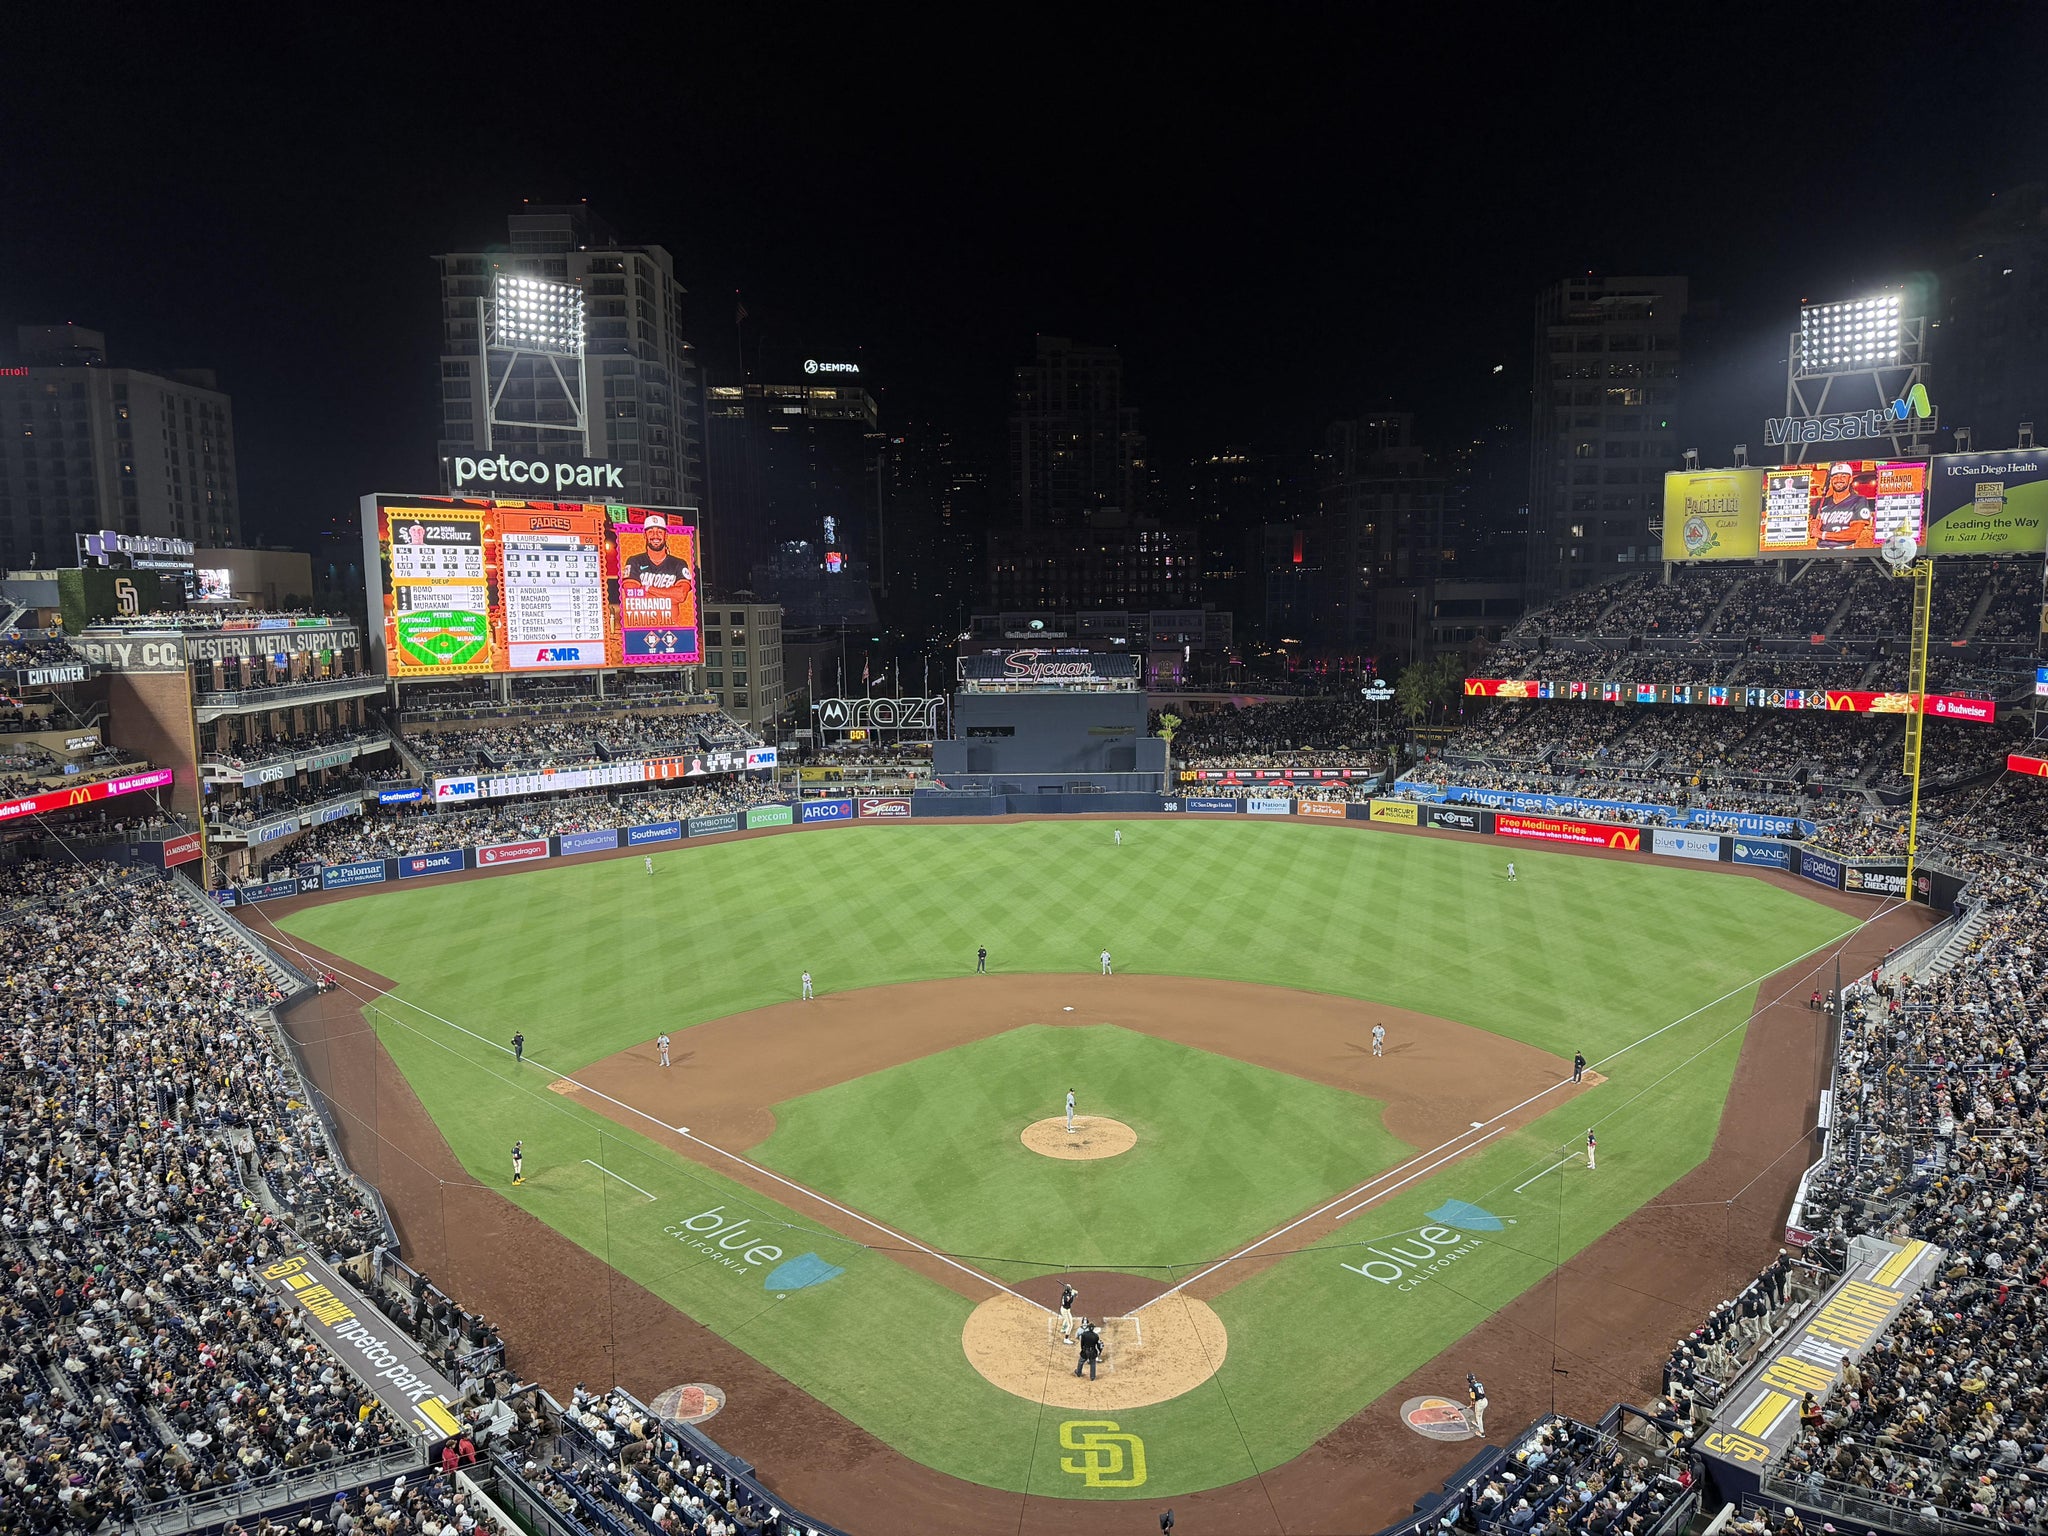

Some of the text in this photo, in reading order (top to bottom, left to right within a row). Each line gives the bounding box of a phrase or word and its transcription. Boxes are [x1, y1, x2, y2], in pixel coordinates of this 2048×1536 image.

[819, 363, 860, 373] SEMPRA
[1768, 409, 1881, 445] Viasat
[455, 454, 624, 492] petco park
[1947, 463, 2038, 476] UC San Diego Health
[530, 517, 571, 531] PADRES
[1946, 518, 2039, 529] Leading the Way
[426, 526, 440, 539] 22
[441, 532, 471, 541] SCHULTZ
[1944, 533, 2008, 542] in San Diego
[625, 598, 672, 610] FERNANDO
[521, 618, 563, 626] CASTELLANOS
[626, 611, 675, 626] TATIS JR.
[187, 630, 359, 660] WESTERN METAL SUPPLY CO.
[142, 643, 185, 666] CO.
[1004, 650, 1095, 684] Sycuan
[28, 666, 84, 685] CUTWATER
[852, 697, 945, 728] razr
[1948, 702, 1987, 717] Budweiser
[850, 730, 866, 740] 0:09
[260, 766, 284, 782] ORIS
[1180, 771, 1197, 781] 0:09
[381, 791, 416, 802] Southwest
[20, 800, 36, 812] Win
[804, 806, 838, 818] ARCO
[863, 799, 906, 816] Sycuan
[1163, 802, 1178, 811] 396
[1385, 807, 1414, 815] MERCURY
[690, 816, 736, 829] CYMBIOTIKA
[1499, 817, 1587, 835] Free Medium Fries
[631, 827, 672, 840] Southwest
[1519, 829, 1546, 838] purchase
[1545, 831, 1562, 839] when
[1572, 834, 1593, 842] Padres
[574, 834, 616, 848] QuidelOrtho
[1655, 836, 1675, 847] blue
[1687, 840, 1708, 850] blue
[499, 845, 541, 859] Snapdragon
[1750, 847, 1789, 860] VANDA
[413, 856, 450, 869] us bank
[1812, 860, 1837, 878] petco
[328, 872, 382, 885] SPECIALTY INSURANCE
[341, 865, 381, 878] Palomar
[1864, 872, 1884, 883] SLAP
[301, 877, 320, 891] 342
[1864, 881, 1900, 892] CHEESE ON
[679, 1205, 783, 1266] blue
[663, 1225, 748, 1276] CALIFORNIA
[1340, 1226, 1461, 1285] blue
[1397, 1238, 1484, 1292] CALIFORNIA
[1804, 1280, 1905, 1350] FAITHFUL
[294, 1283, 357, 1328] WELCOME
[344, 1324, 399, 1369] petco
[375, 1363, 435, 1403] park
[1791, 1334, 1850, 1368] THE
[1760, 1355, 1838, 1401] FOR
[1059, 1420, 1148, 1488] SD
